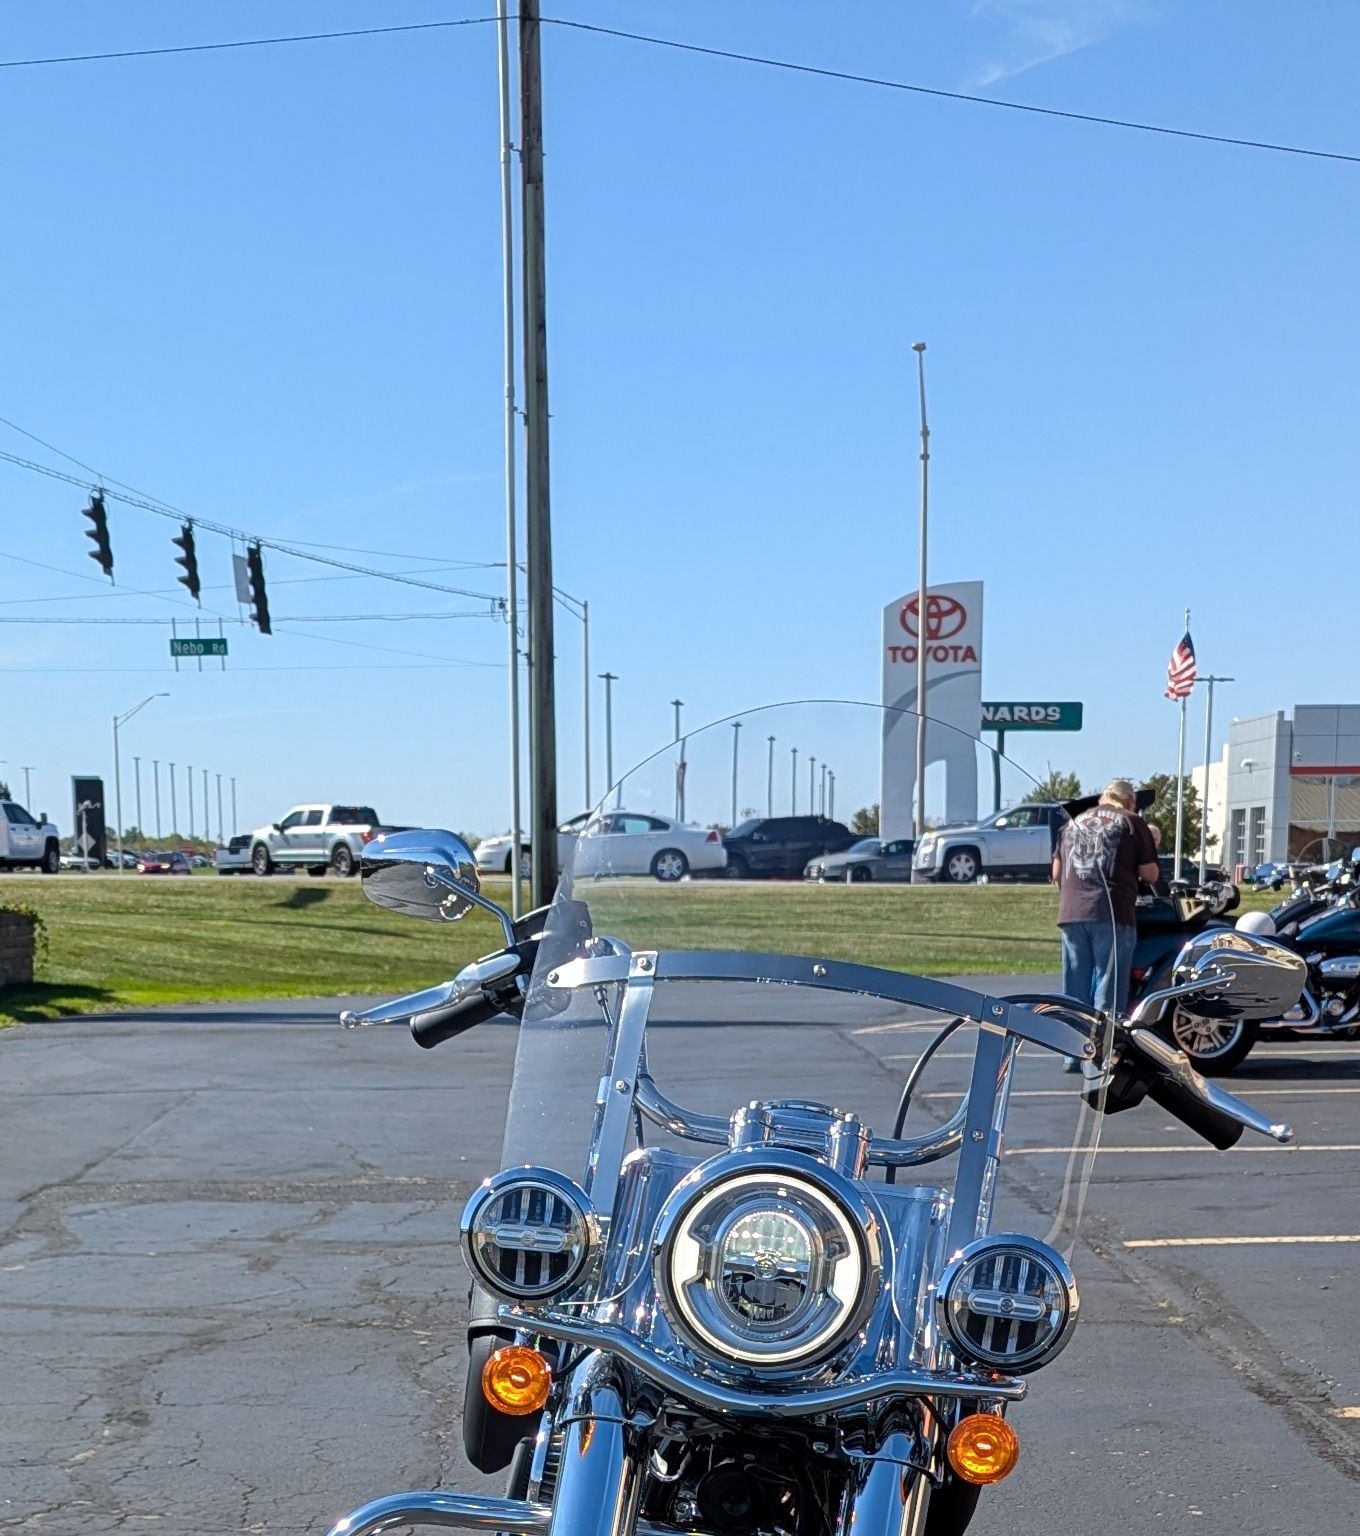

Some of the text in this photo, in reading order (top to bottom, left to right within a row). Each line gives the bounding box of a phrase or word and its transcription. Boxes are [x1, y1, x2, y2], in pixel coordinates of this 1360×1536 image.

[173, 641, 225, 654] Nebo Rd
[981, 706, 1061, 721] NARDS
